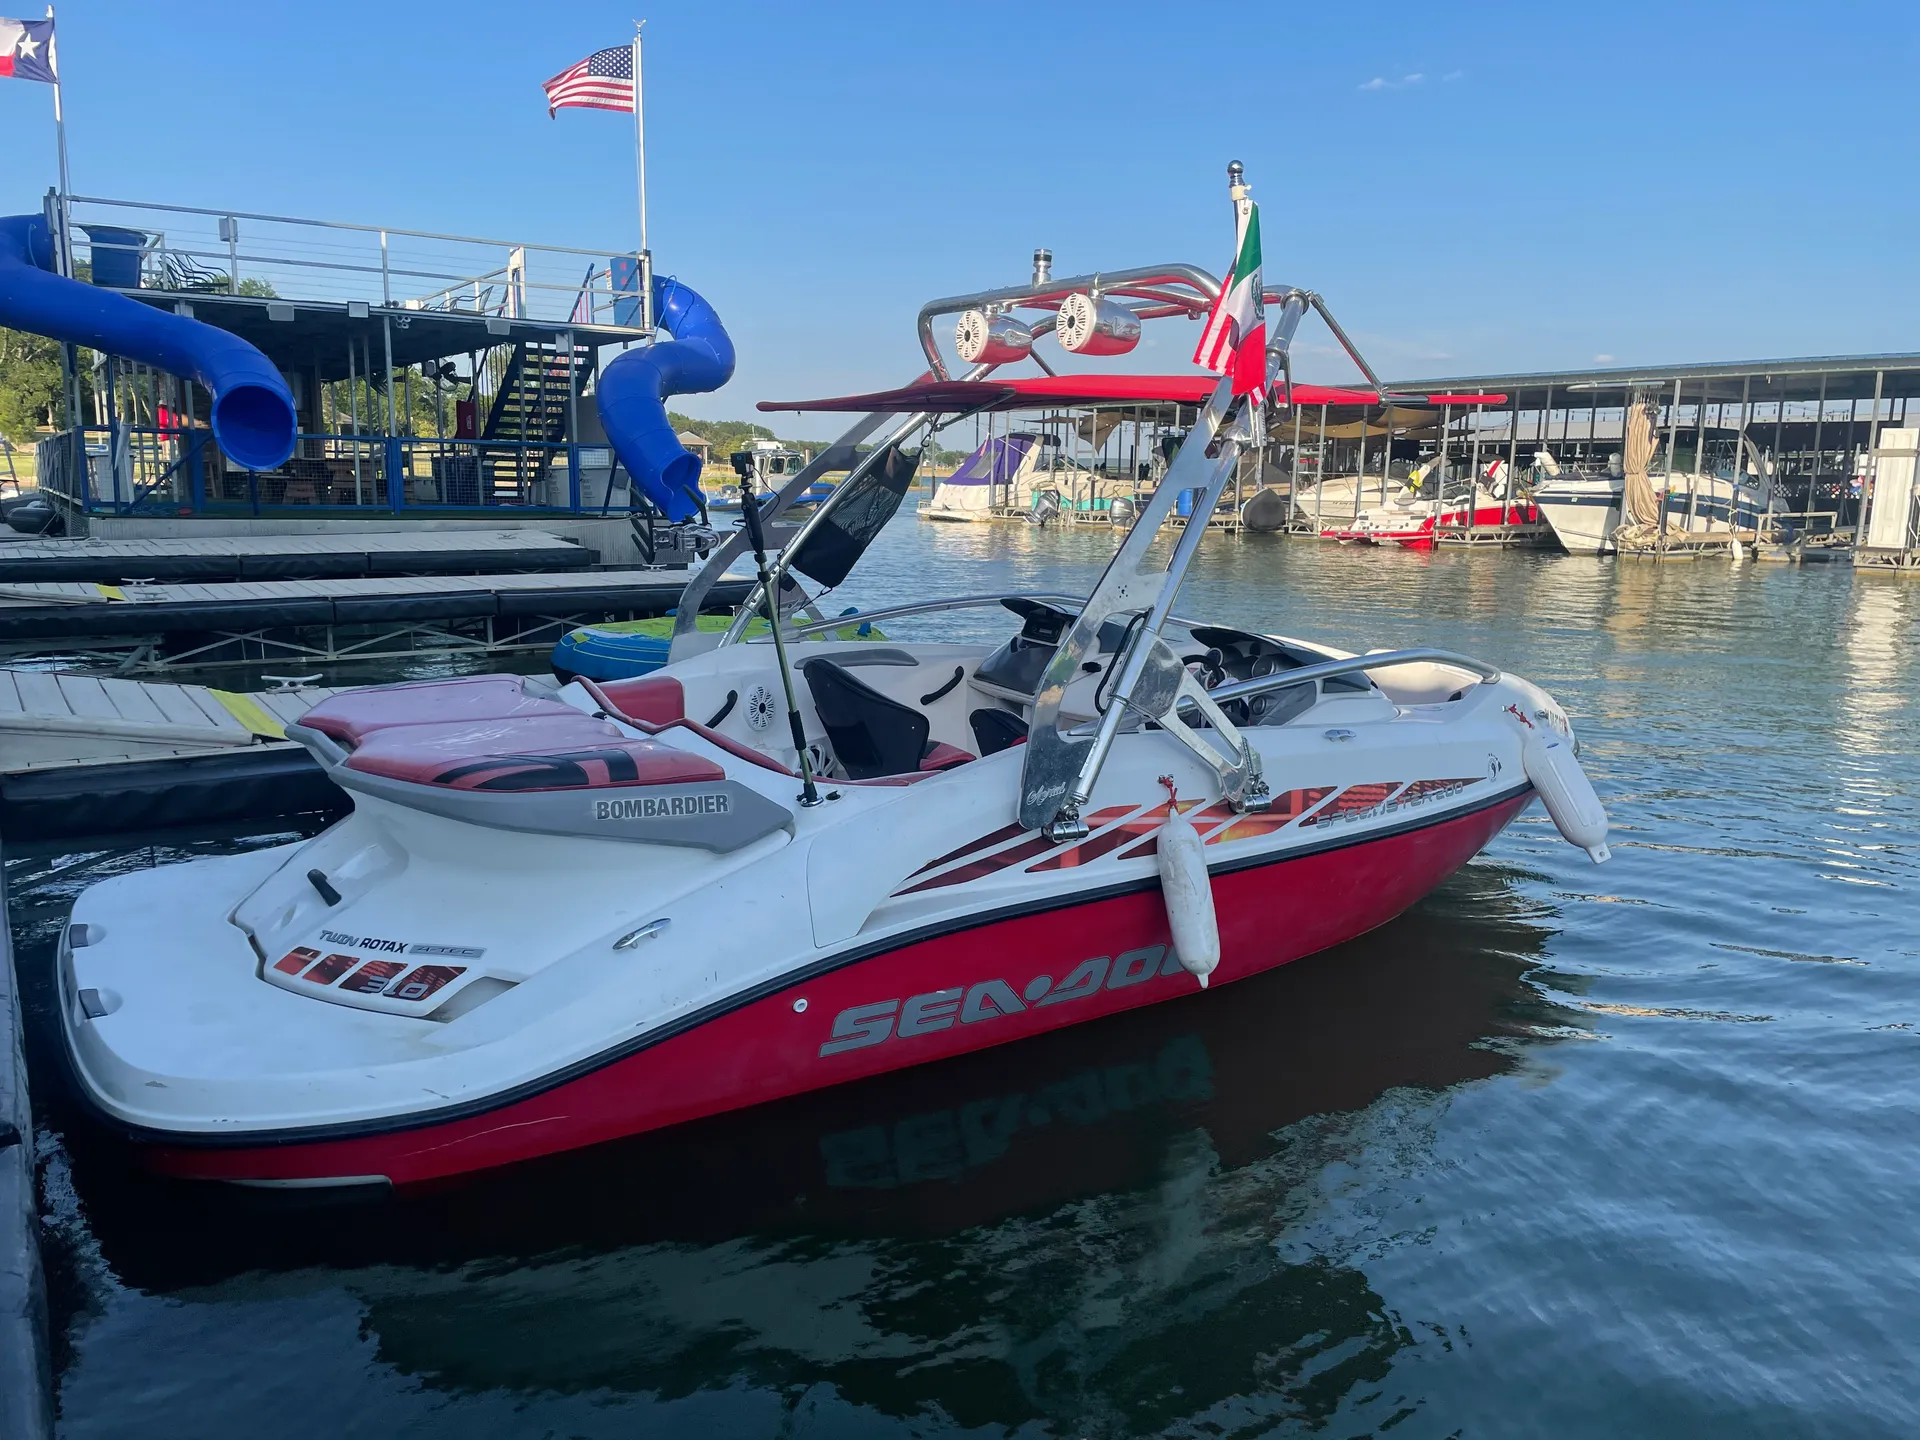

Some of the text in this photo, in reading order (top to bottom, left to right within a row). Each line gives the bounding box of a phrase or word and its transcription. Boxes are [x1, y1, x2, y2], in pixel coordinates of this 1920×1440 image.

[1436, 781, 1464, 801] 200
[596, 794, 729, 820] BOMBARDIER
[320, 930, 360, 947] TWIN
[359, 938, 408, 954] ROTAX
[360, 975, 428, 1000] 310
